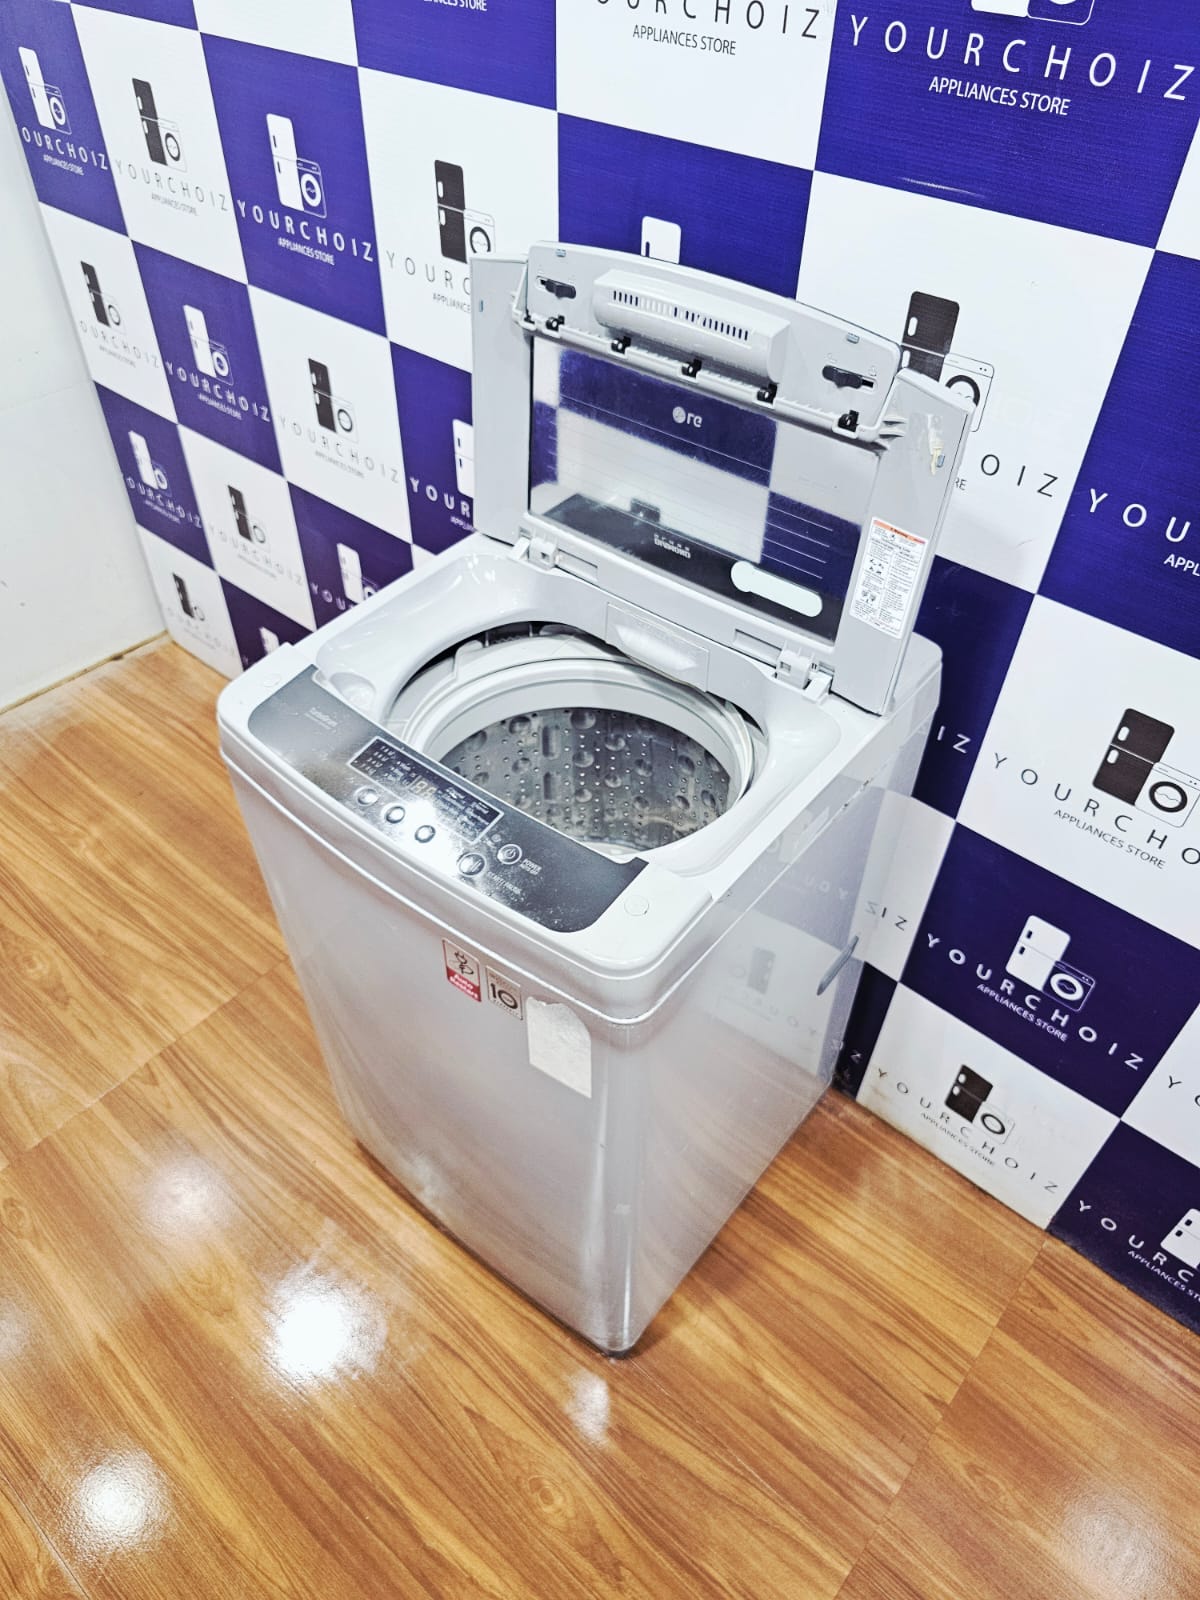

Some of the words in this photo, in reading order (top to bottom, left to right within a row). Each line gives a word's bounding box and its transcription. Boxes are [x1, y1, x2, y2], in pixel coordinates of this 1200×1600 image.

[633, 24, 698, 48] APPLIANCES
[700, 36, 737, 56] STORE
[850, 14, 1196, 101] YOURCHOIZ
[928, 76, 1018, 106] APPLIANCES
[1020, 92, 1071, 116] STORE
[115, 159, 228, 212] YOURCHOIZ
[236, 199, 374, 262] YOURCHOIZ
[164, 360, 271, 423] YOURCHOIZ
[409, 476, 471, 518] YOUR
[1089, 488, 1192, 543] YOU
[1053, 808, 1124, 849] APPLIANCES
[1126, 843, 1166, 870] STORE
[927, 933, 1144, 1071] YOURCHOIZ
[976, 983, 1035, 1023] APPLIANCES
[1034, 1017, 1069, 1043] STORE
[878, 1068, 1058, 1194] YOURCHOIZ
[1079, 1200, 1195, 1282] YOURC
[1127, 1250, 1186, 1291] APPLIANCES
